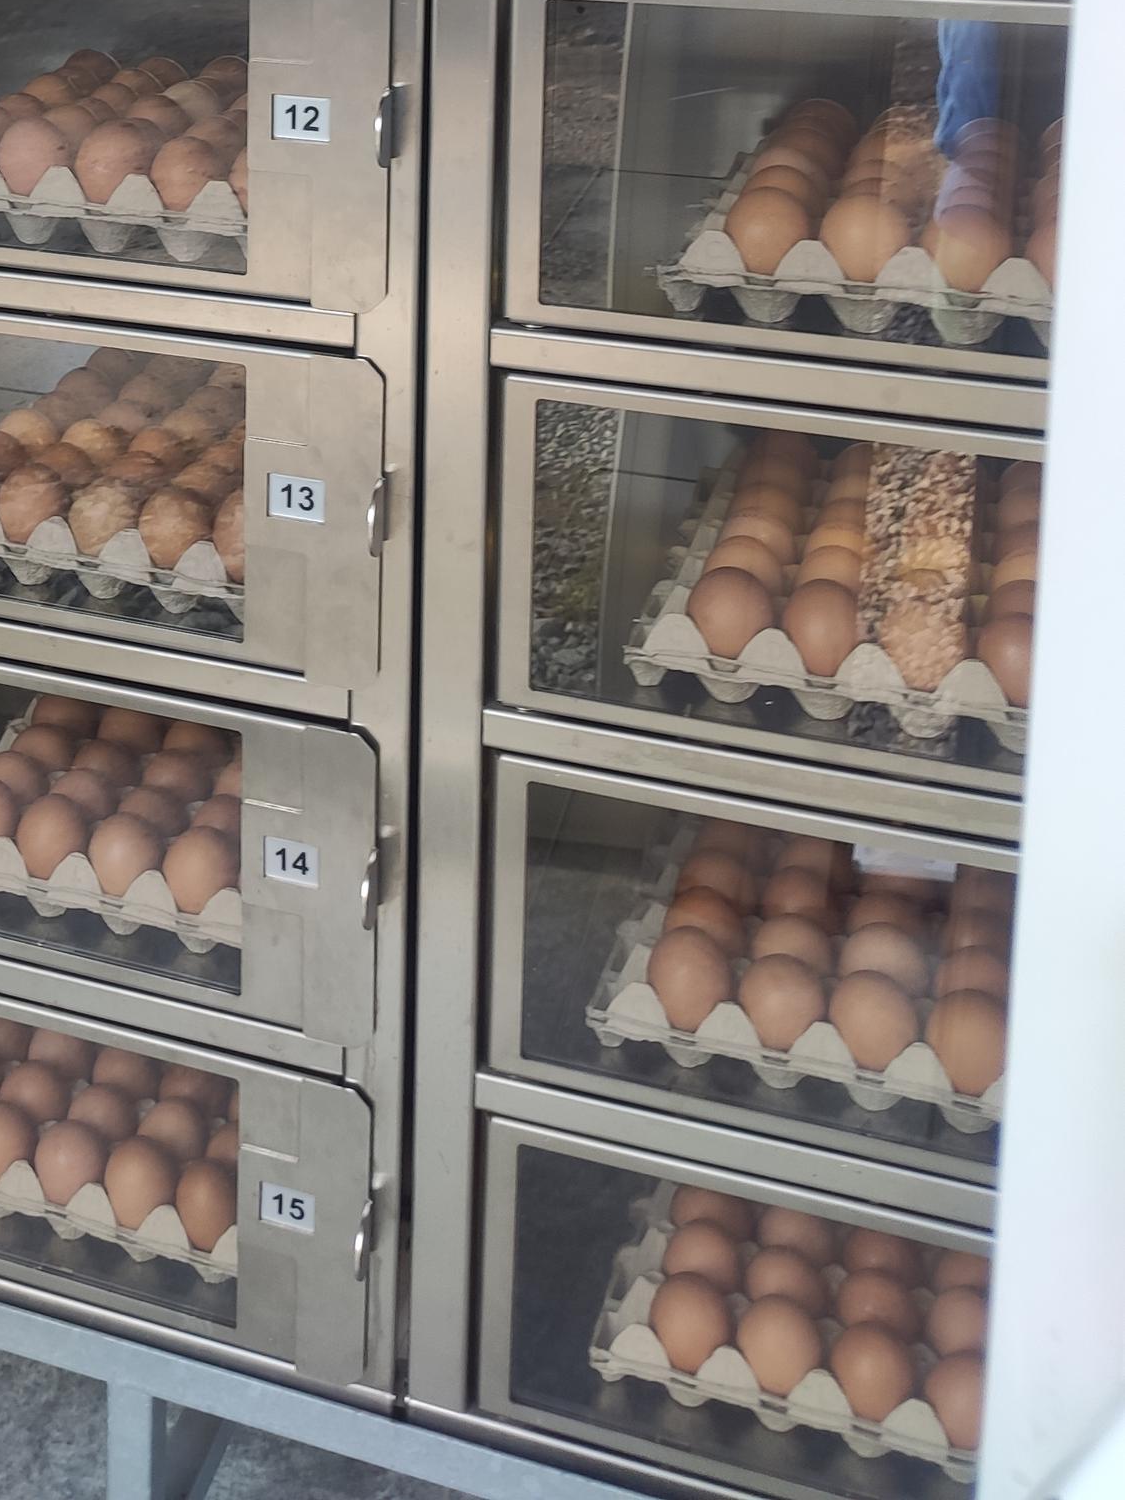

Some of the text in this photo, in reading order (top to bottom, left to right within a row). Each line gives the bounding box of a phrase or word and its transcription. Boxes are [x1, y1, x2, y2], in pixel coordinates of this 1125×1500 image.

[285, 104, 320, 132] 12
[281, 483, 315, 512] 13
[275, 847, 309, 876] 14
[272, 1193, 306, 1221] 15
